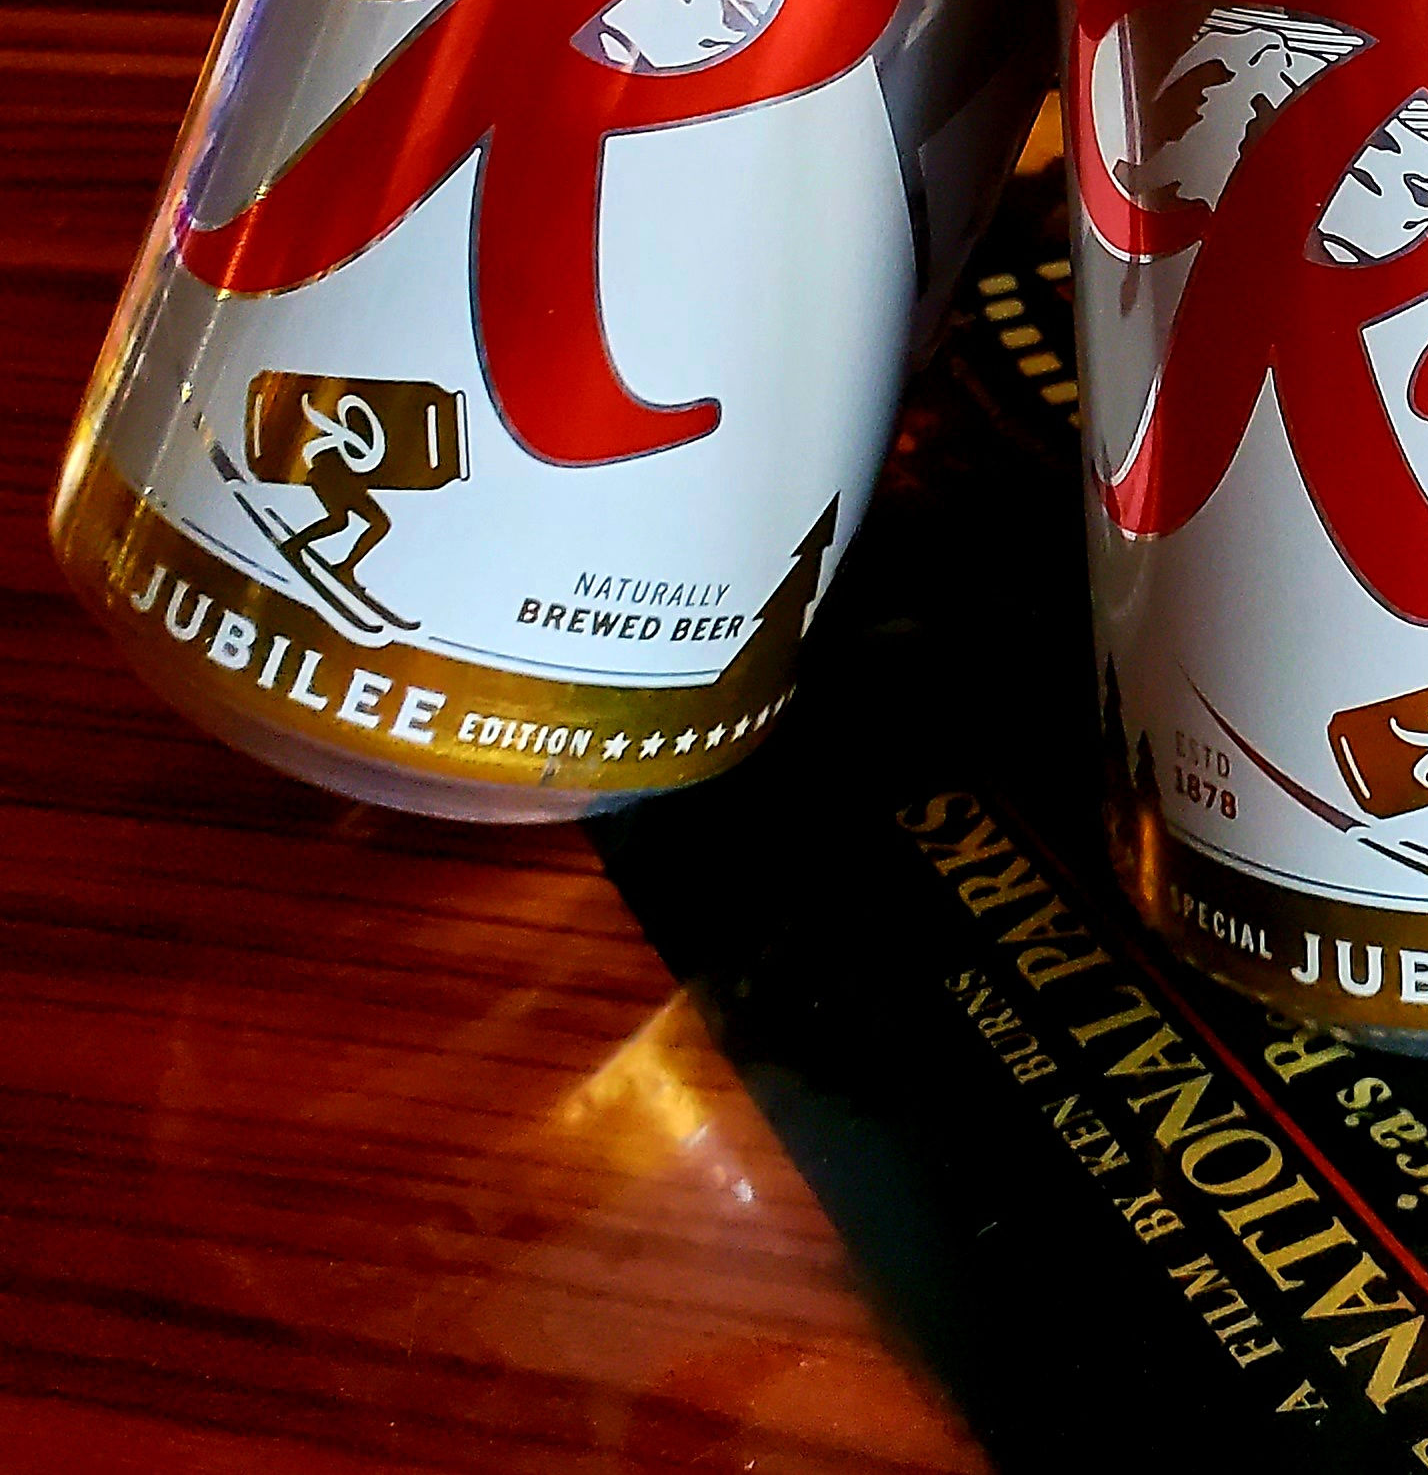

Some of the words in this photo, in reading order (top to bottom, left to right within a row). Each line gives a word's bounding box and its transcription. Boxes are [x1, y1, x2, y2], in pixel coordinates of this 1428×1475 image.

[516, 596, 661, 643] BREWED
[668, 611, 744, 642] BEER
[574, 571, 732, 609] NATURALLY
[130, 563, 448, 746] JUBILEE
[456, 710, 593, 759] EDITION
[1175, 764, 1239, 821] 1878
[895, 791, 1112, 993] PARKS
[943, 966, 1059, 1086] BURNS
[1041, 1092, 1130, 1177] KEN
[1111, 1188, 1187, 1245] BY
[1166, 1251, 1284, 1369] FILM
[1275, 1378, 1329, 1415] A
